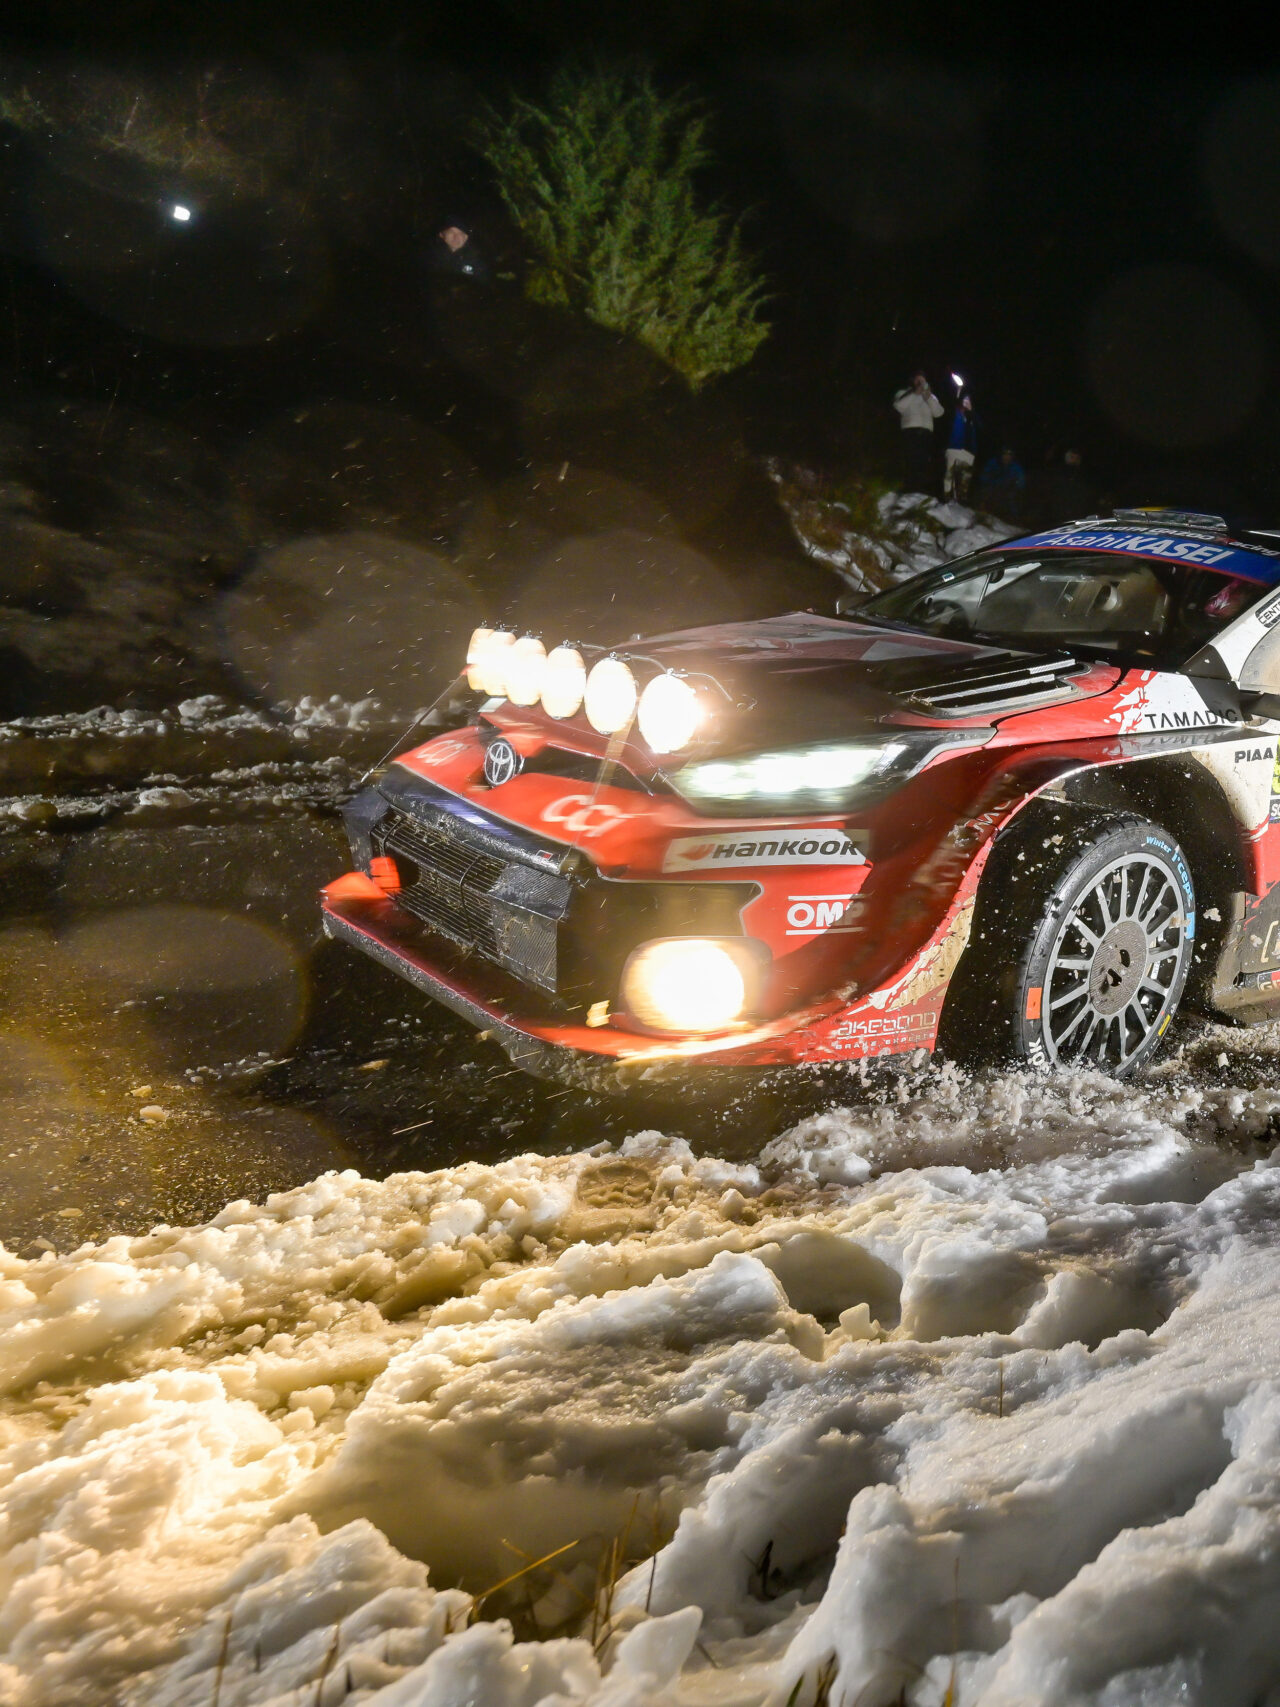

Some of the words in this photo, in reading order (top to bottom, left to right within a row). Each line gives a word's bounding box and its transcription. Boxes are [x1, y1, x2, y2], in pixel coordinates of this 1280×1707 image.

[1035, 533, 1235, 565] AsahiKASEI
[1144, 708, 1239, 729] TAMADIC
[1234, 747, 1274, 764] PIAA
[1146, 836, 1172, 854] Winter
[787, 901, 866, 928] OMP
